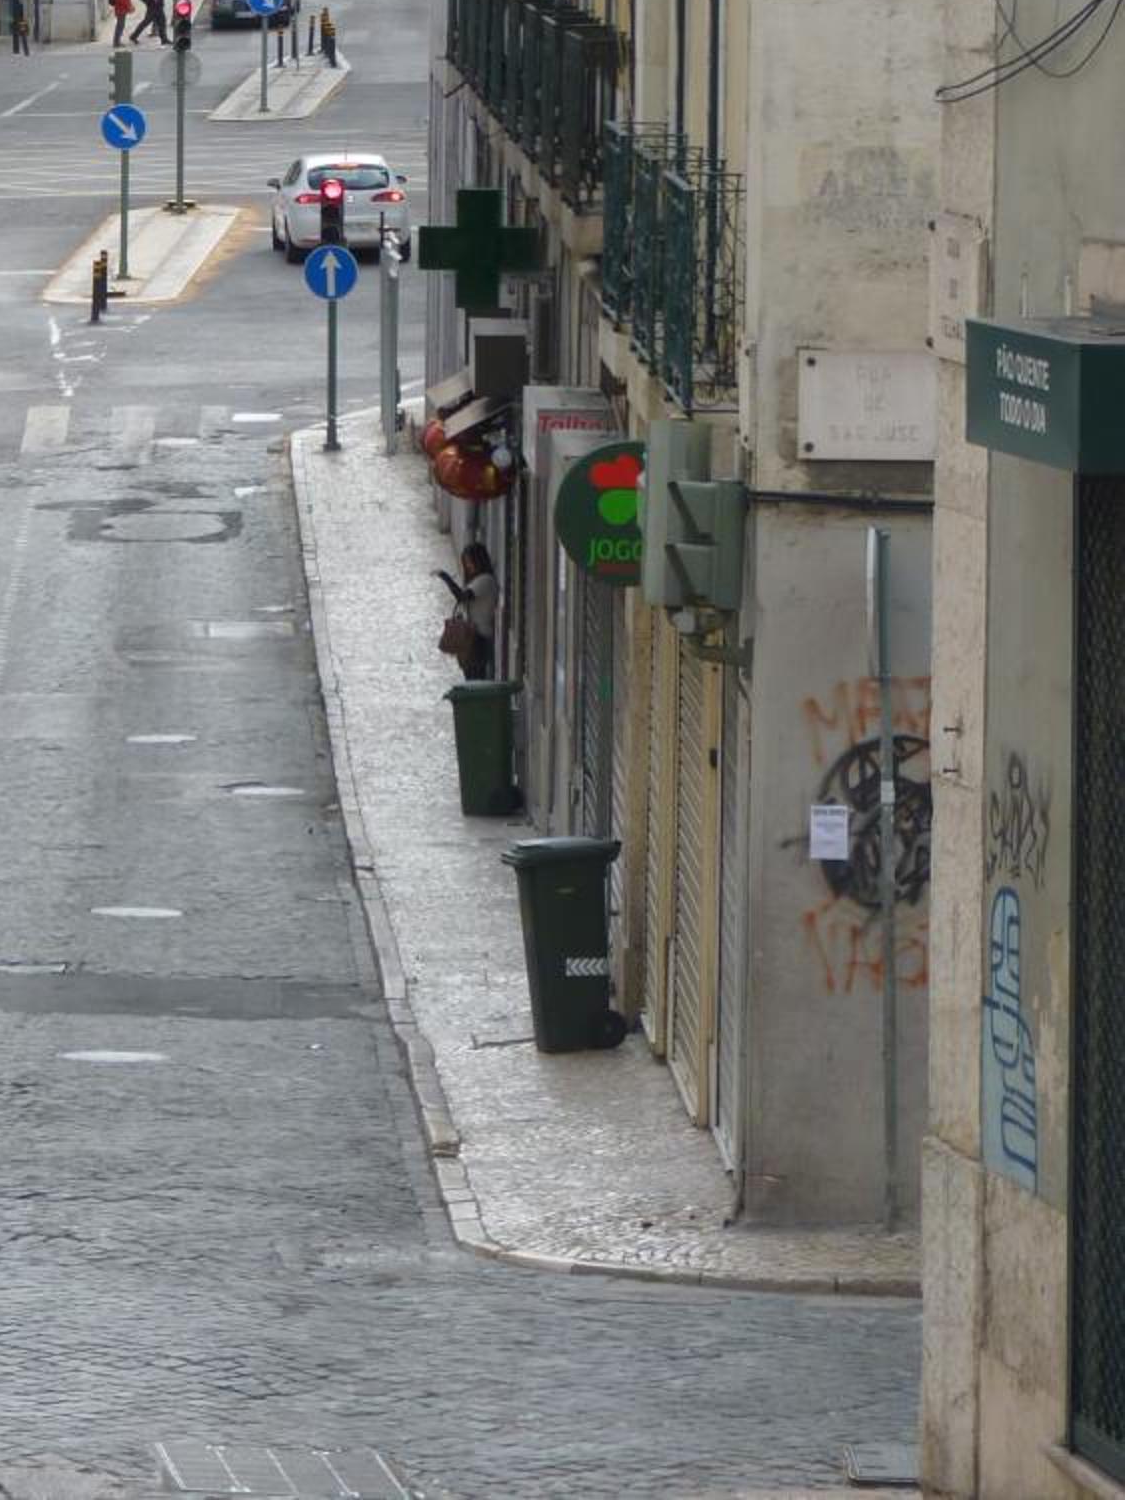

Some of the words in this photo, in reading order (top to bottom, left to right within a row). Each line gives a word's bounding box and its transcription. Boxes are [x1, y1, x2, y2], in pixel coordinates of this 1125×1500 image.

[1016, 353, 1050, 391] QUENTE
[999, 390, 1022, 426] TODO
[1031, 400, 1047, 436] DIA
